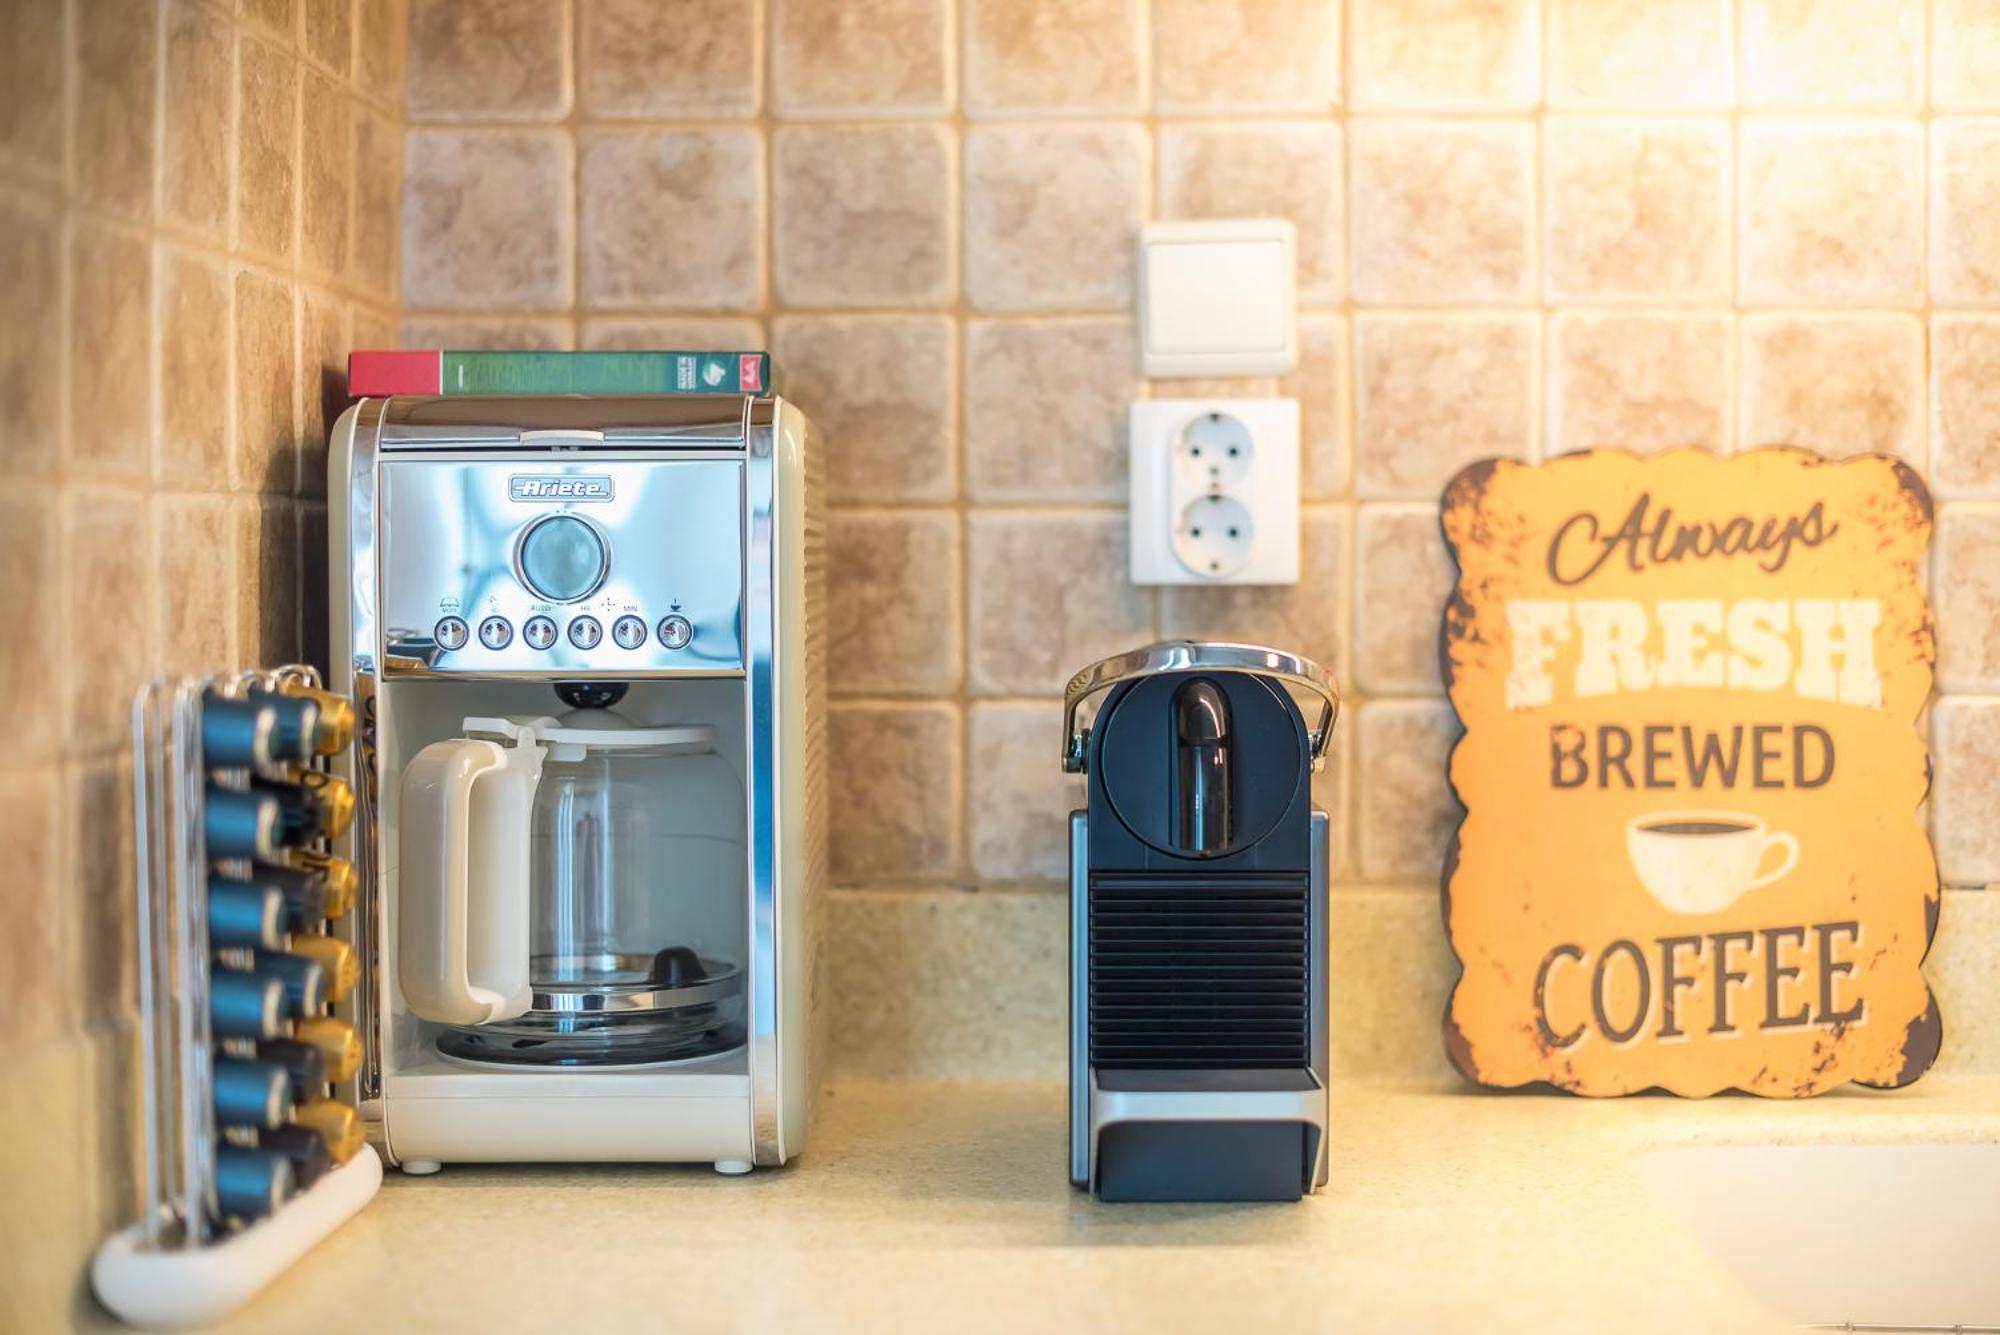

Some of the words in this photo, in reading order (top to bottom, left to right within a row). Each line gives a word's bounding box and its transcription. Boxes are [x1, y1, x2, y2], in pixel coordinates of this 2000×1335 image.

[514, 480, 609, 497] Ariete
[1548, 492, 1839, 586] Always
[1506, 599, 1883, 710] FRESH
[1551, 724, 1836, 790] BREWED
[1533, 921, 1866, 1050] COFFEE
